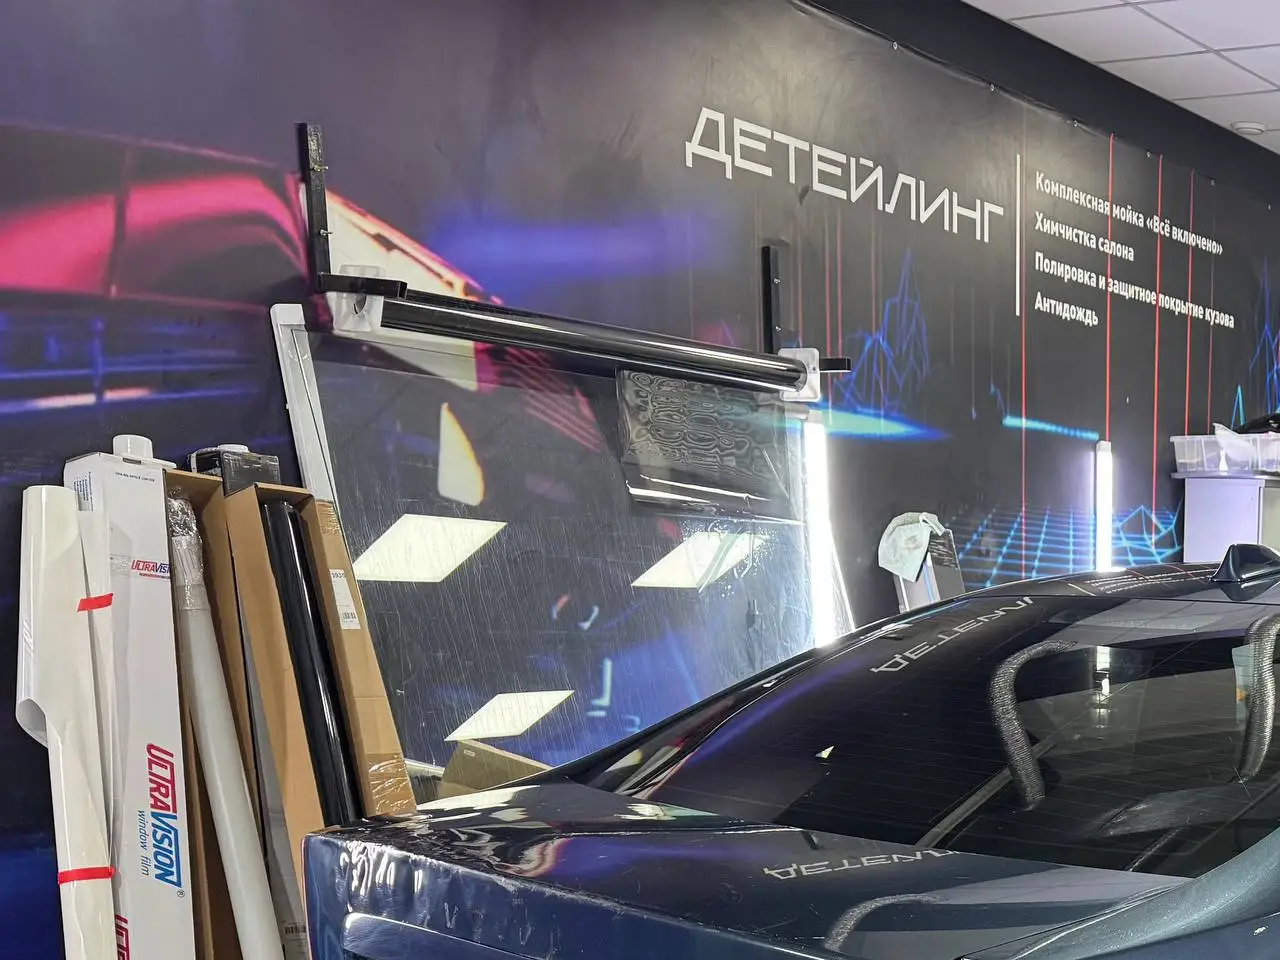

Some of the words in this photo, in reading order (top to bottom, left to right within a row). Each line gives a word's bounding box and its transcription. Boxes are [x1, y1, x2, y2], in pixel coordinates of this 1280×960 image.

[685, 106, 1004, 243] ДЕТЕЙЛИНГ
[1034, 210, 1097, 249] Химчистка
[1097, 236, 1135, 261] салона
[1035, 170, 1110, 217] Комплексная
[1112, 203, 1145, 229] мойка
[1146, 214, 1171, 237] «Всё
[1171, 225, 1224, 255] включено»
[1034, 290, 1099, 327] Антидождь
[1035, 250, 1097, 288] Полировка
[1098, 274, 1106, 291] и
[1107, 277, 1157, 305] защитное
[1158, 292, 1204, 319] покрытие
[1204, 307, 1235, 329] кузова
[137, 810, 150, 851] window
[145, 742, 182, 888] ULTRAVISION
[140, 855, 151, 877] film
